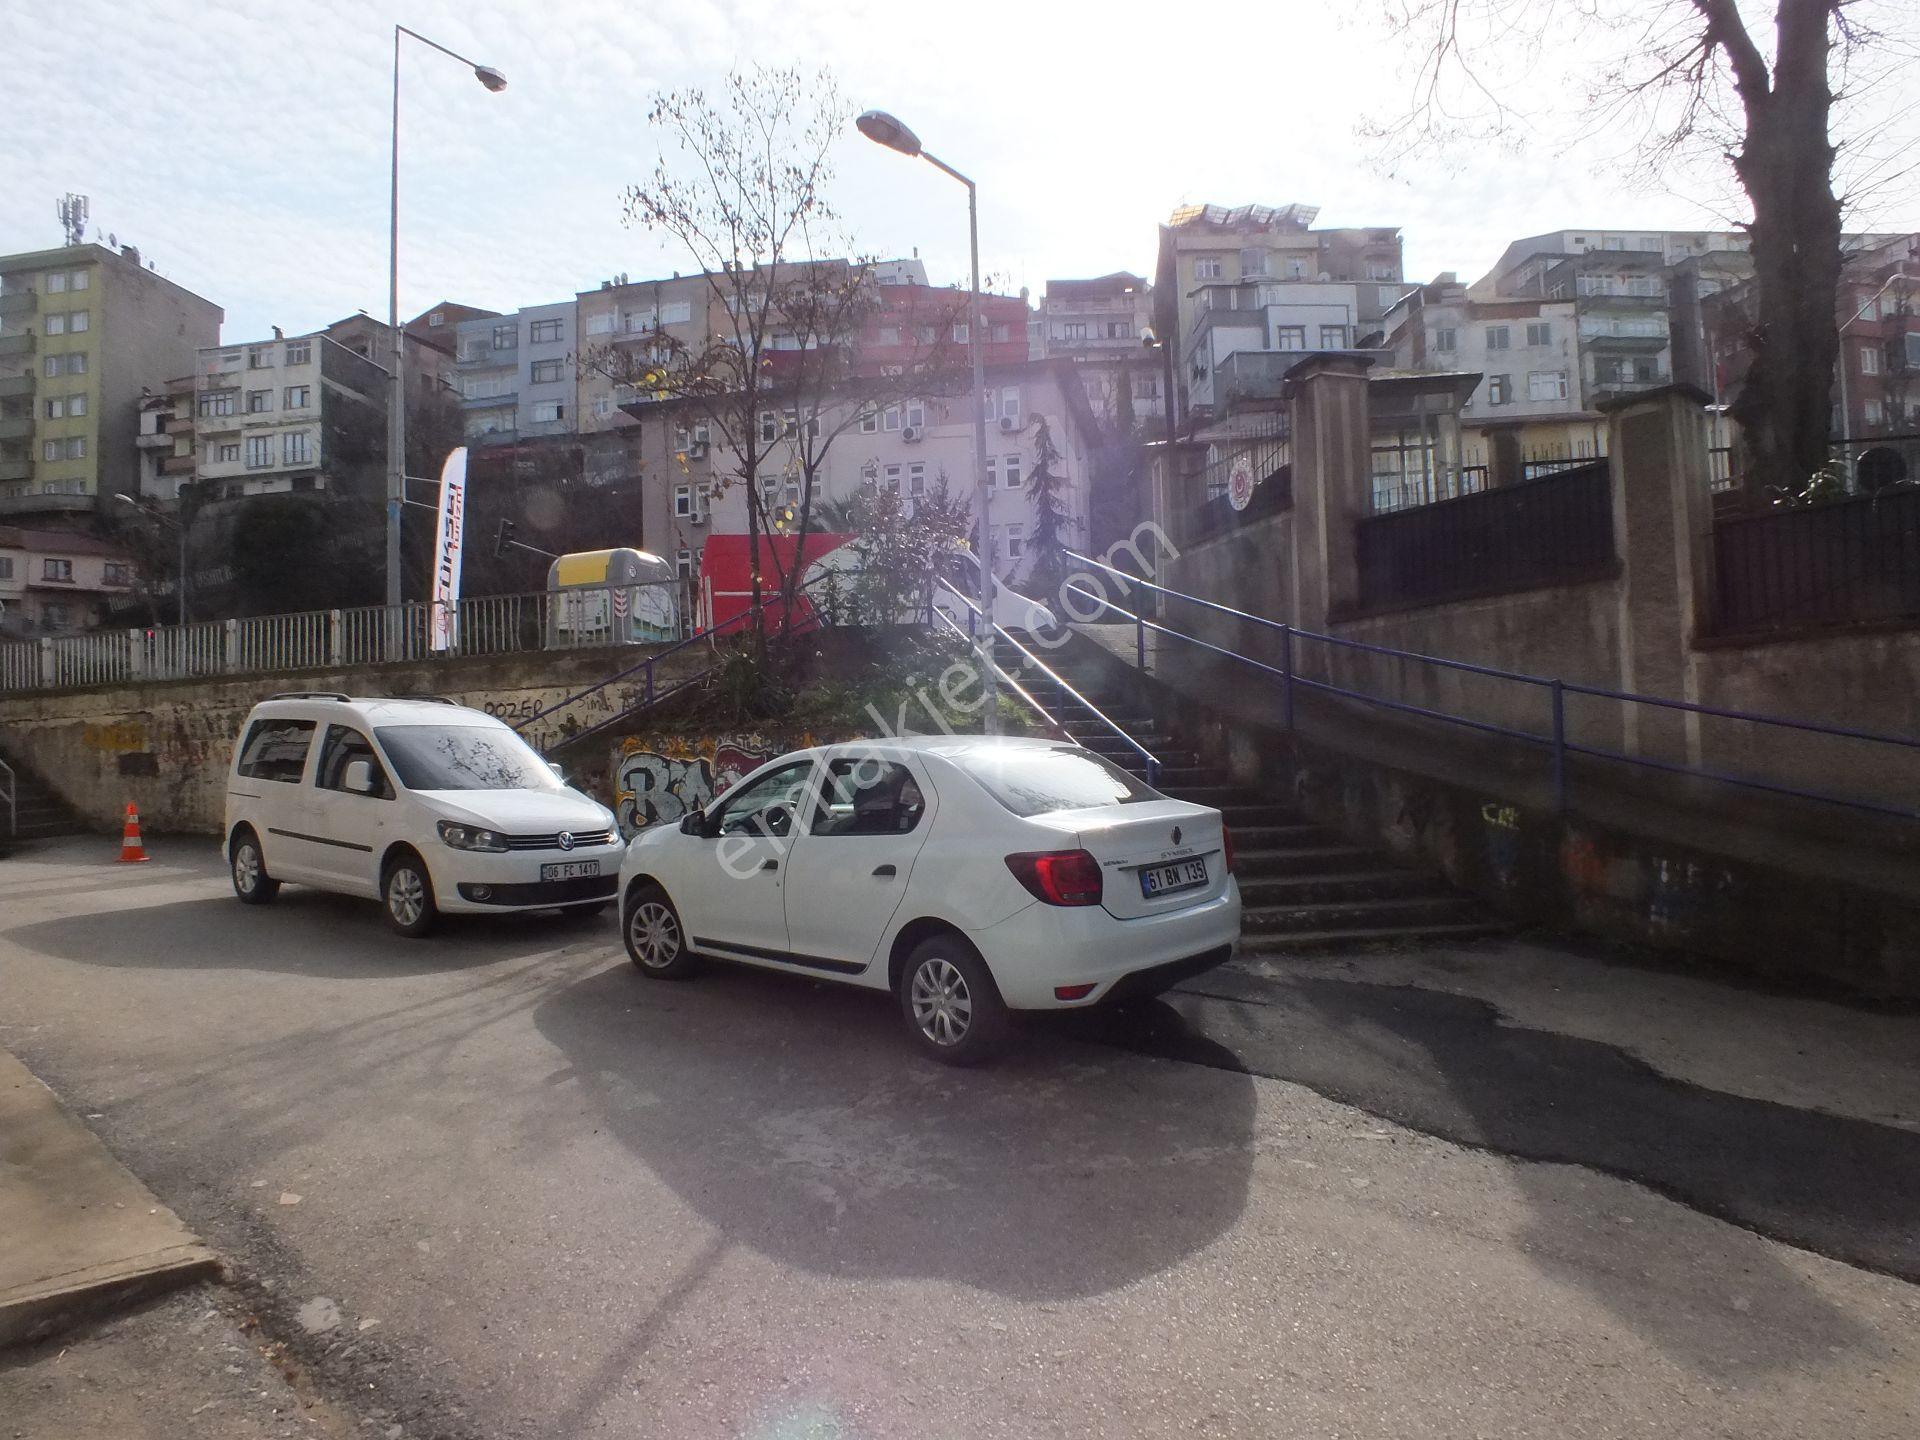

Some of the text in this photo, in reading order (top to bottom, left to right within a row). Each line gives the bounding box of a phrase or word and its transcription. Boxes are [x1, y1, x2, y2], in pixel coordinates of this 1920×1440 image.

[548, 862, 598, 878] 06 FC 1417
[1149, 861, 1205, 890] 61 BN 135
